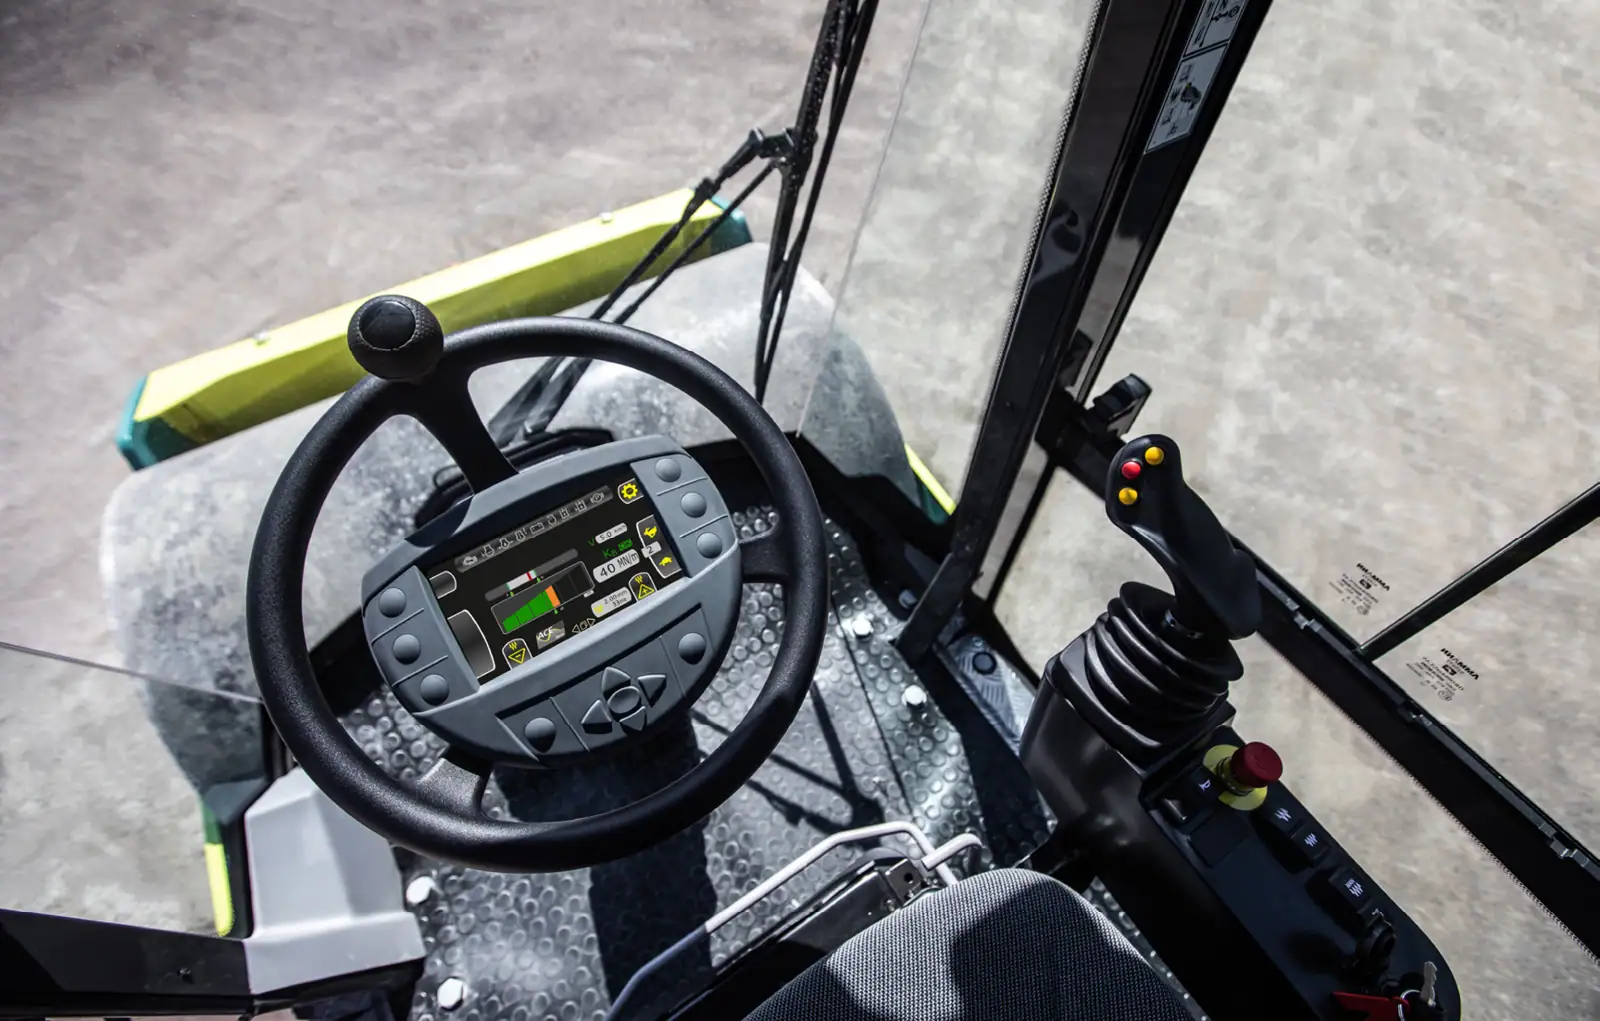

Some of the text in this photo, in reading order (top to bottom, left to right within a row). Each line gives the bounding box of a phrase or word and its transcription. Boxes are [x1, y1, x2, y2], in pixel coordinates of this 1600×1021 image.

[600, 532, 612, 540] 5.0
[646, 546, 654, 554] 2
[600, 552, 638, 577] 40 MN/m
[538, 626, 553, 639] ACE
